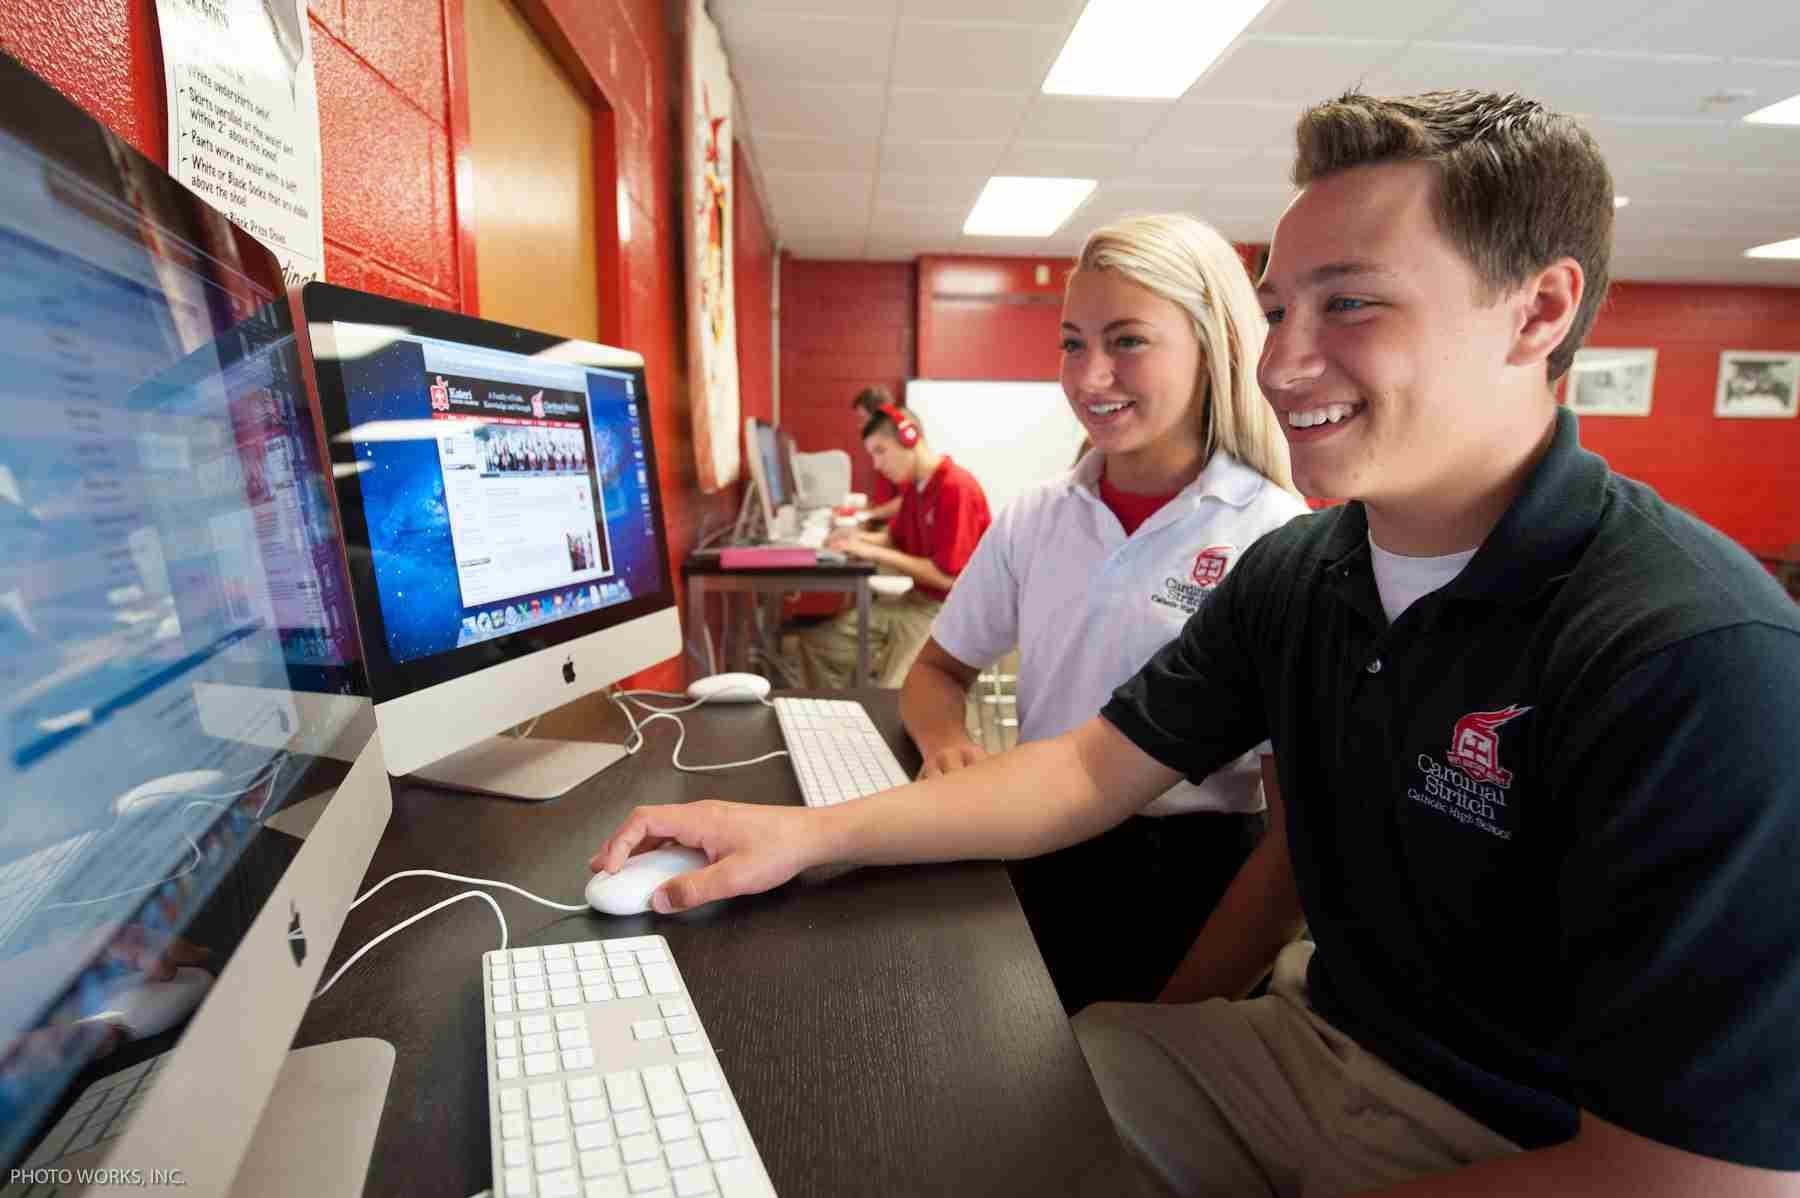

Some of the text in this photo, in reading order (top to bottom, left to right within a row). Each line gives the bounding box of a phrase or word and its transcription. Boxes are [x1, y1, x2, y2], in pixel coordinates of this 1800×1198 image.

[191, 129, 213, 153] Pants
[236, 157, 244, 168] at
[191, 153, 216, 178] White
[217, 169, 227, 181] or
[227, 172, 247, 192] Black
[191, 174, 214, 196] above
[214, 183, 228, 201] the
[1425, 774, 1495, 820] Stritch
